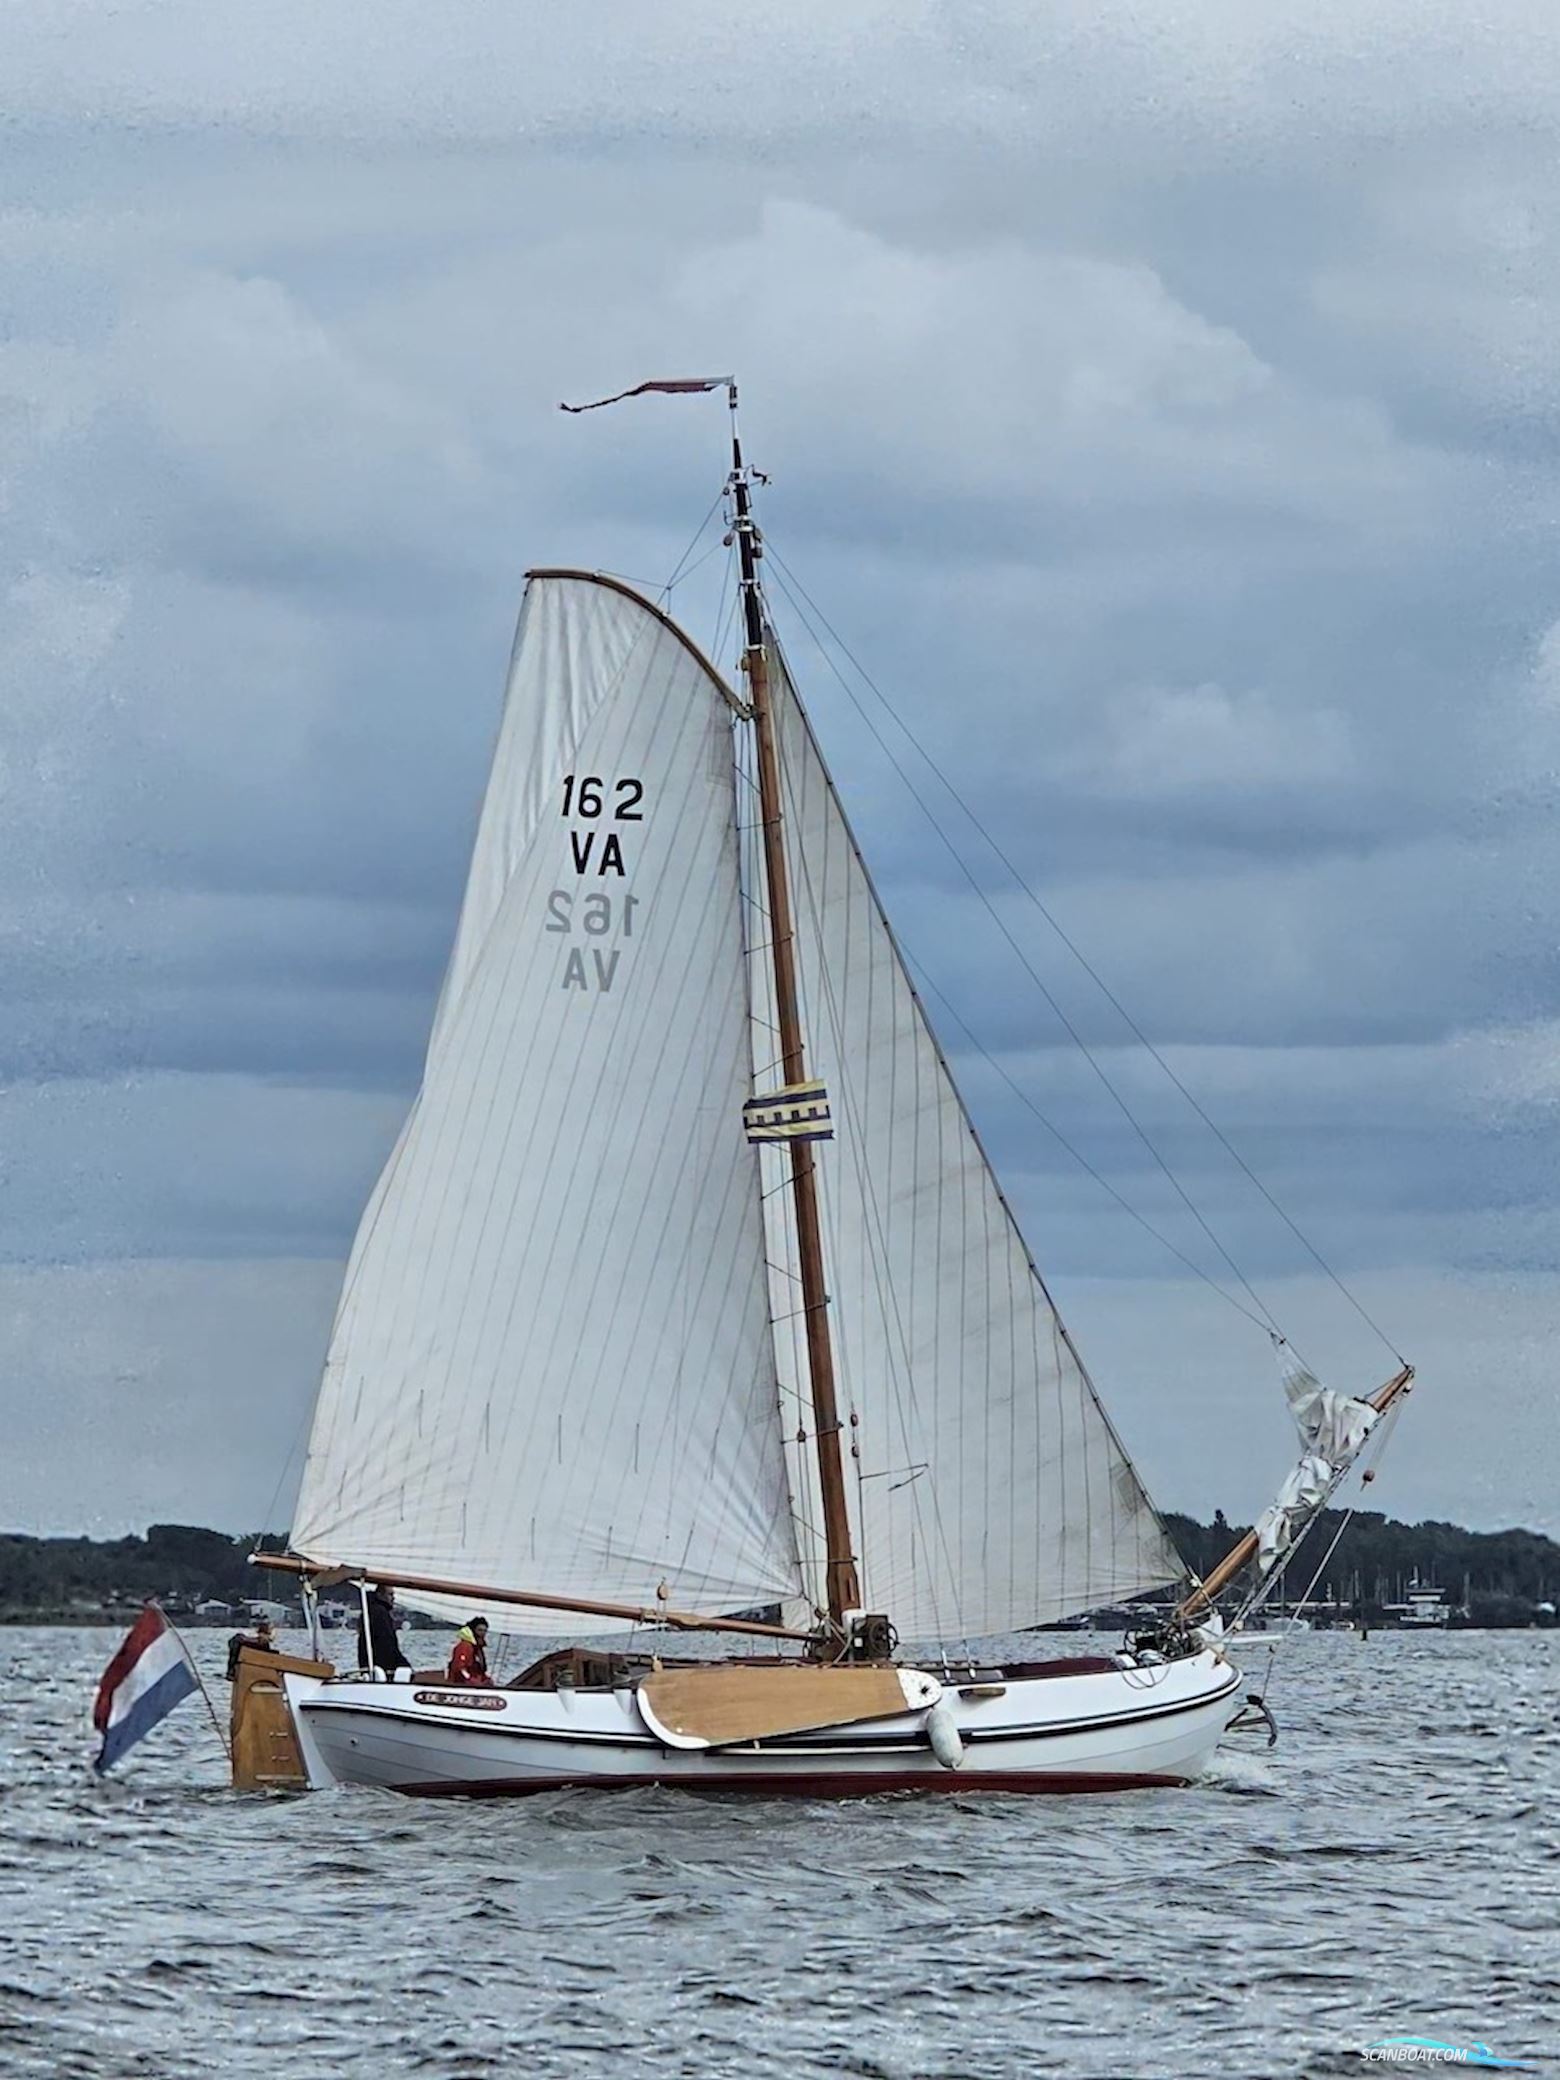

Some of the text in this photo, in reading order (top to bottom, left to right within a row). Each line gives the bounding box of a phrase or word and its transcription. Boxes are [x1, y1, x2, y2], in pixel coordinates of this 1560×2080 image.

[562, 775, 643, 821] 162
[571, 831, 625, 876] VA
[426, 1693, 439, 1702] DE
